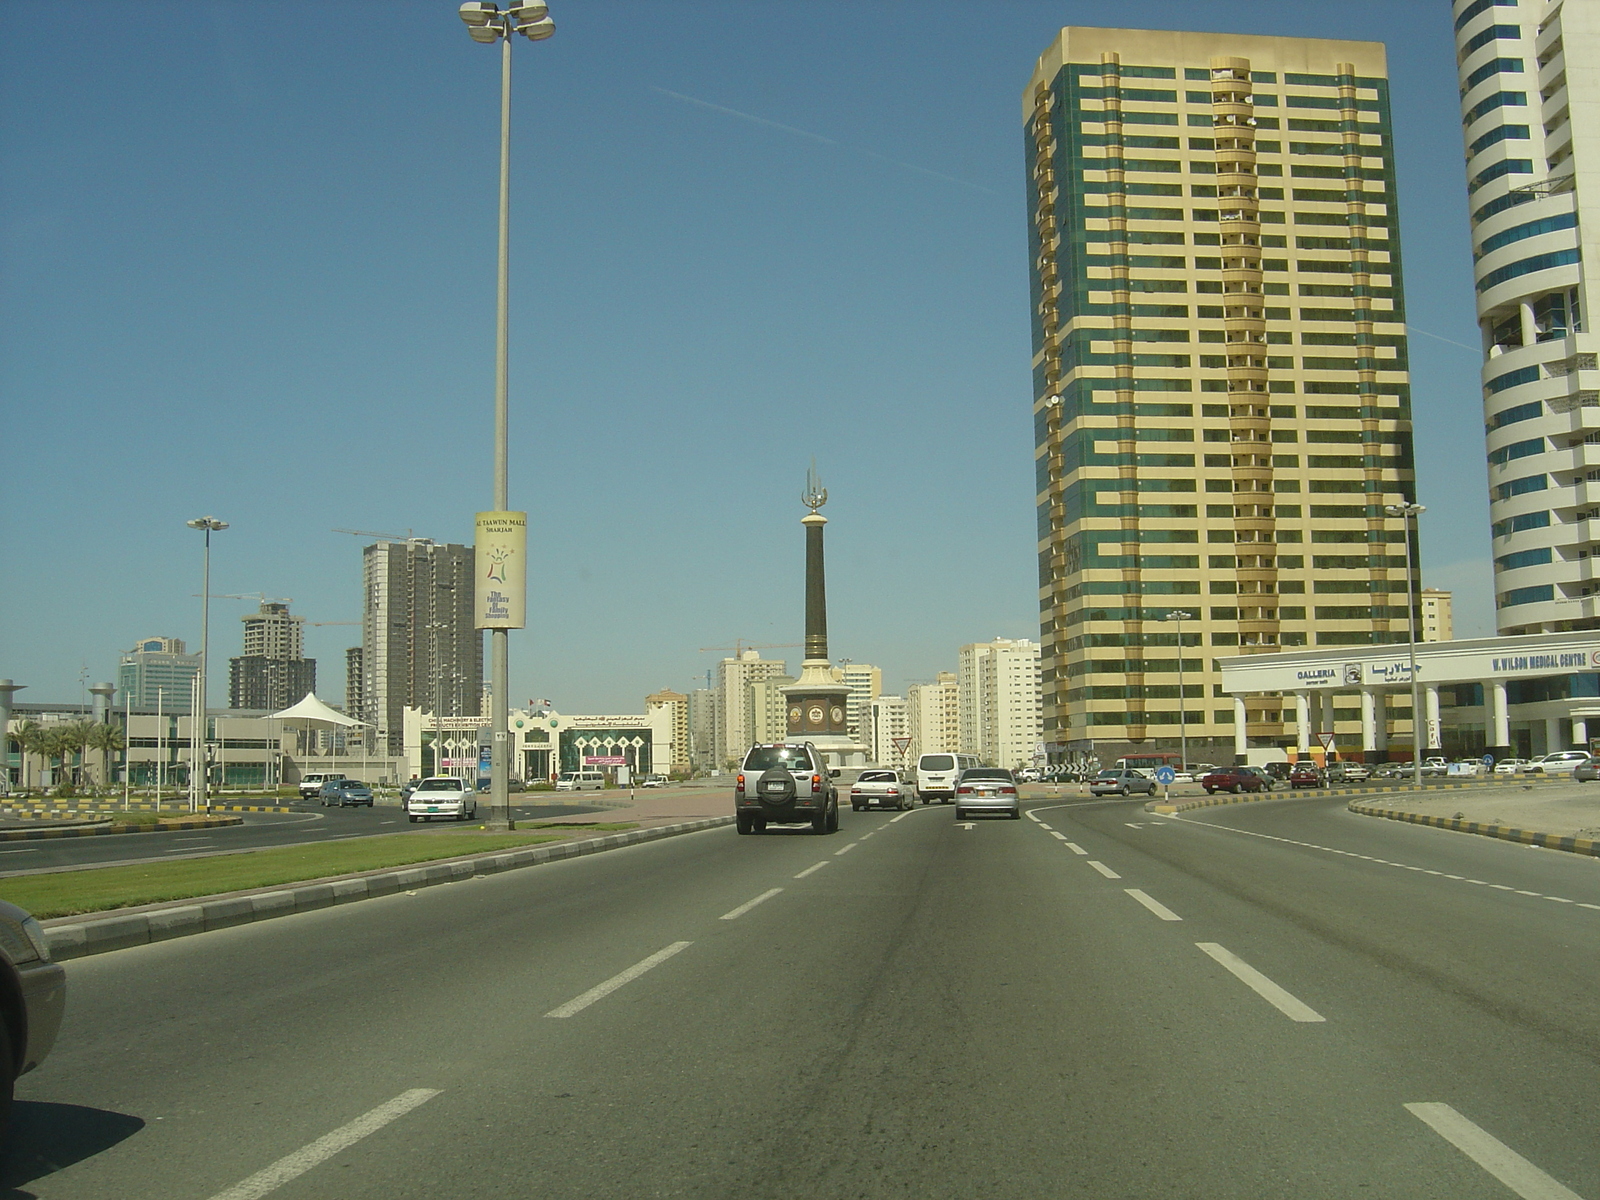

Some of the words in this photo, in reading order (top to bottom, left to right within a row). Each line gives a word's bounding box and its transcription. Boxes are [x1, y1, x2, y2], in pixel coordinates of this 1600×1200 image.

[1501, 656, 1528, 671] WILSON
[1529, 654, 1559, 669] MEDICAL
[1560, 652, 1586, 667] CENTRE
[1297, 669, 1336, 679] GALLERIA
